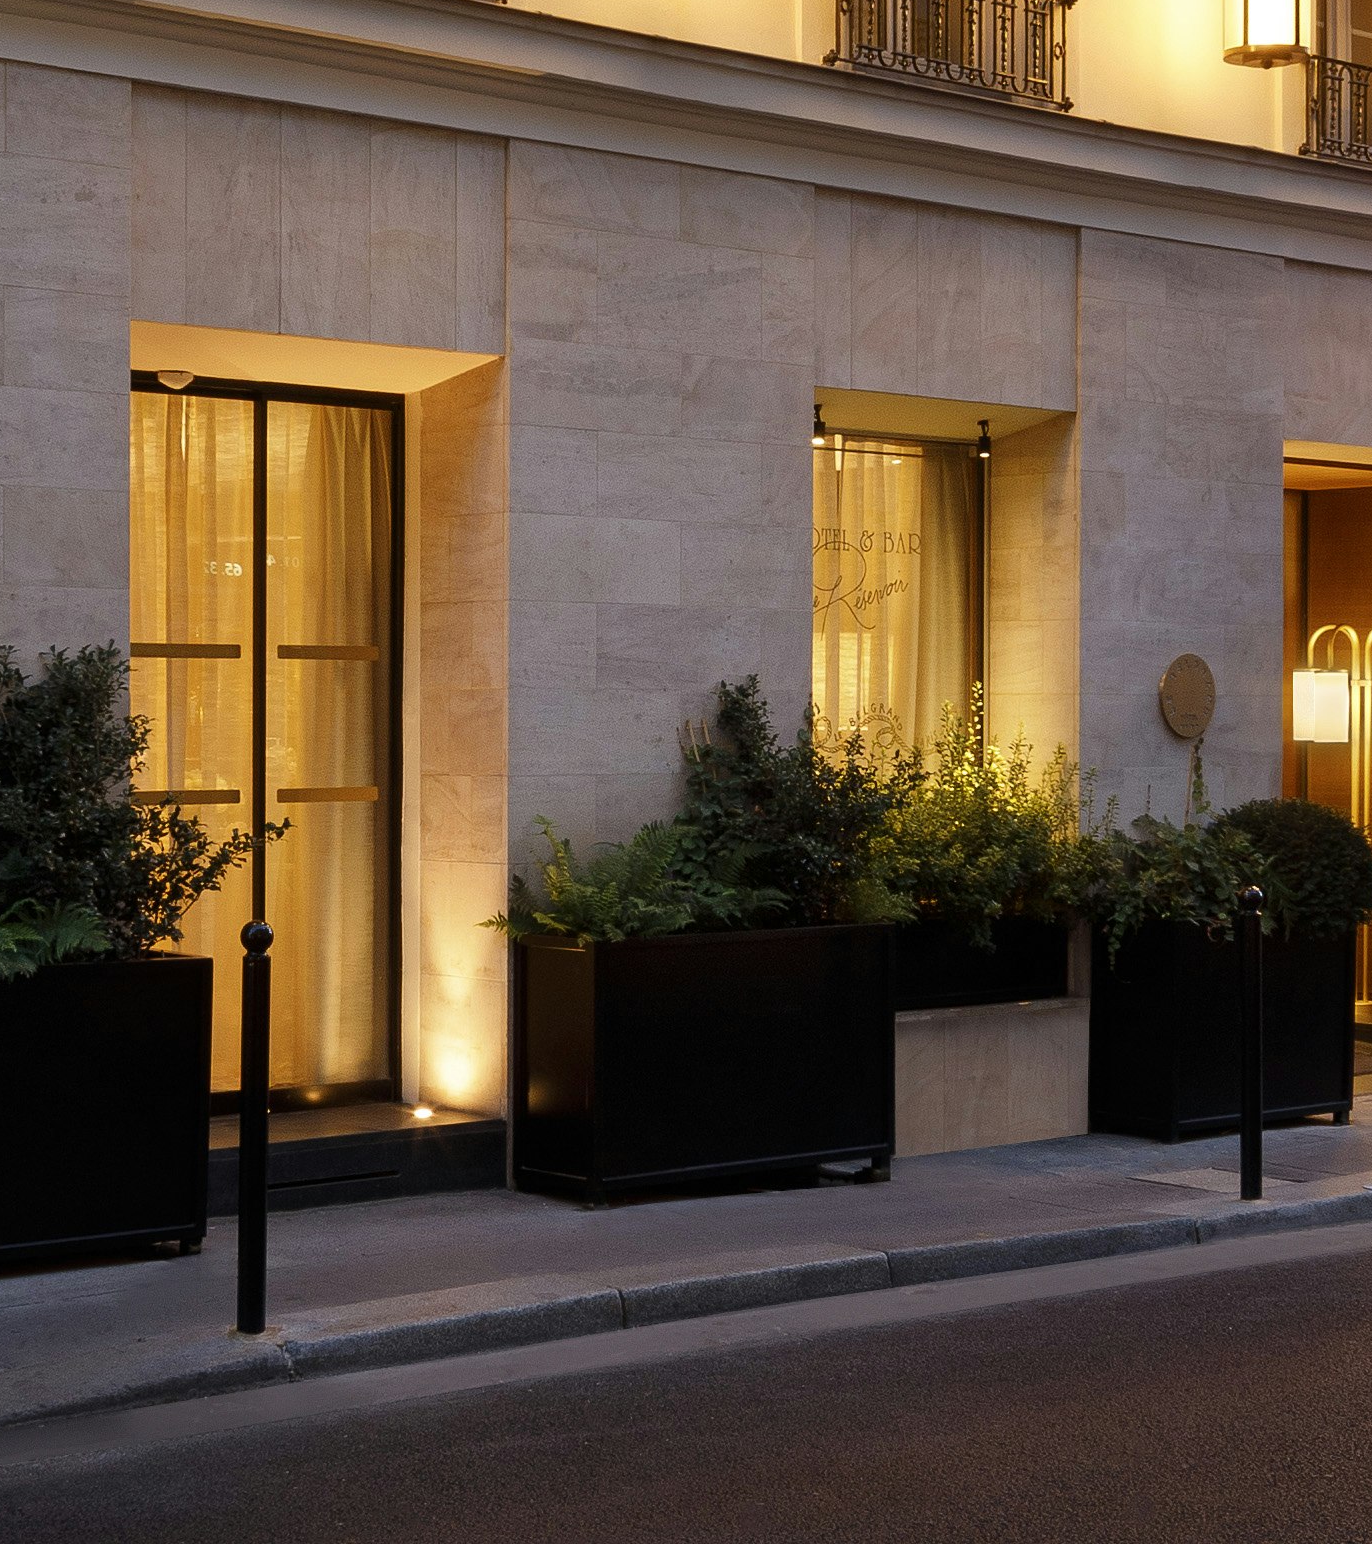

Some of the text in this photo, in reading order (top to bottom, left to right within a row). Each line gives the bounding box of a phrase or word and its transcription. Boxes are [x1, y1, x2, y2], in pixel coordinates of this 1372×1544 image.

[859, 530, 875, 553] &
[883, 531, 922, 555] BAR
[848, 702, 903, 731] BELGRAND
